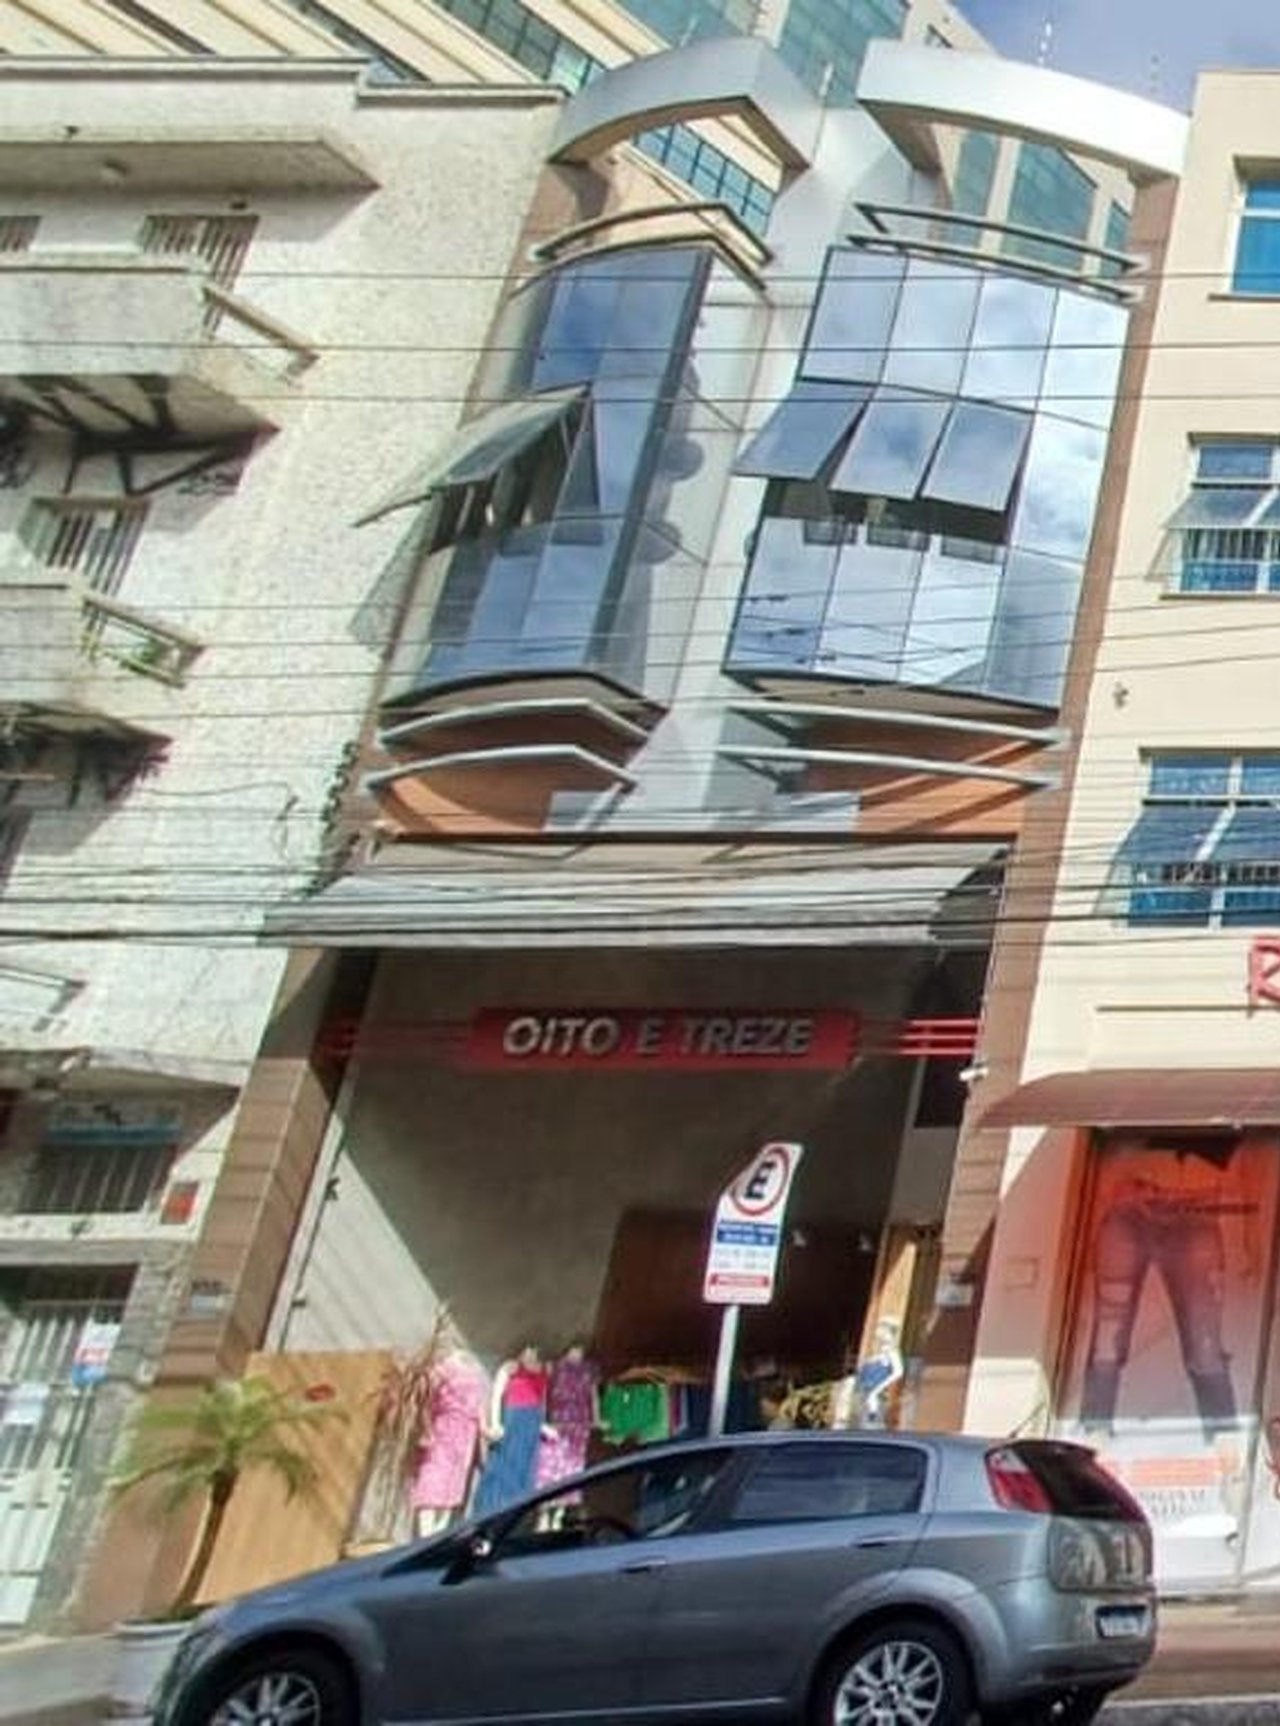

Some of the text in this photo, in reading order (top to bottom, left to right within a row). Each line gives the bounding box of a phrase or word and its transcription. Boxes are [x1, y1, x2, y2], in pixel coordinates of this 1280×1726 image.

[501, 1015, 814, 1056] OITO E TREZE
[743, 1160, 777, 1200] E
